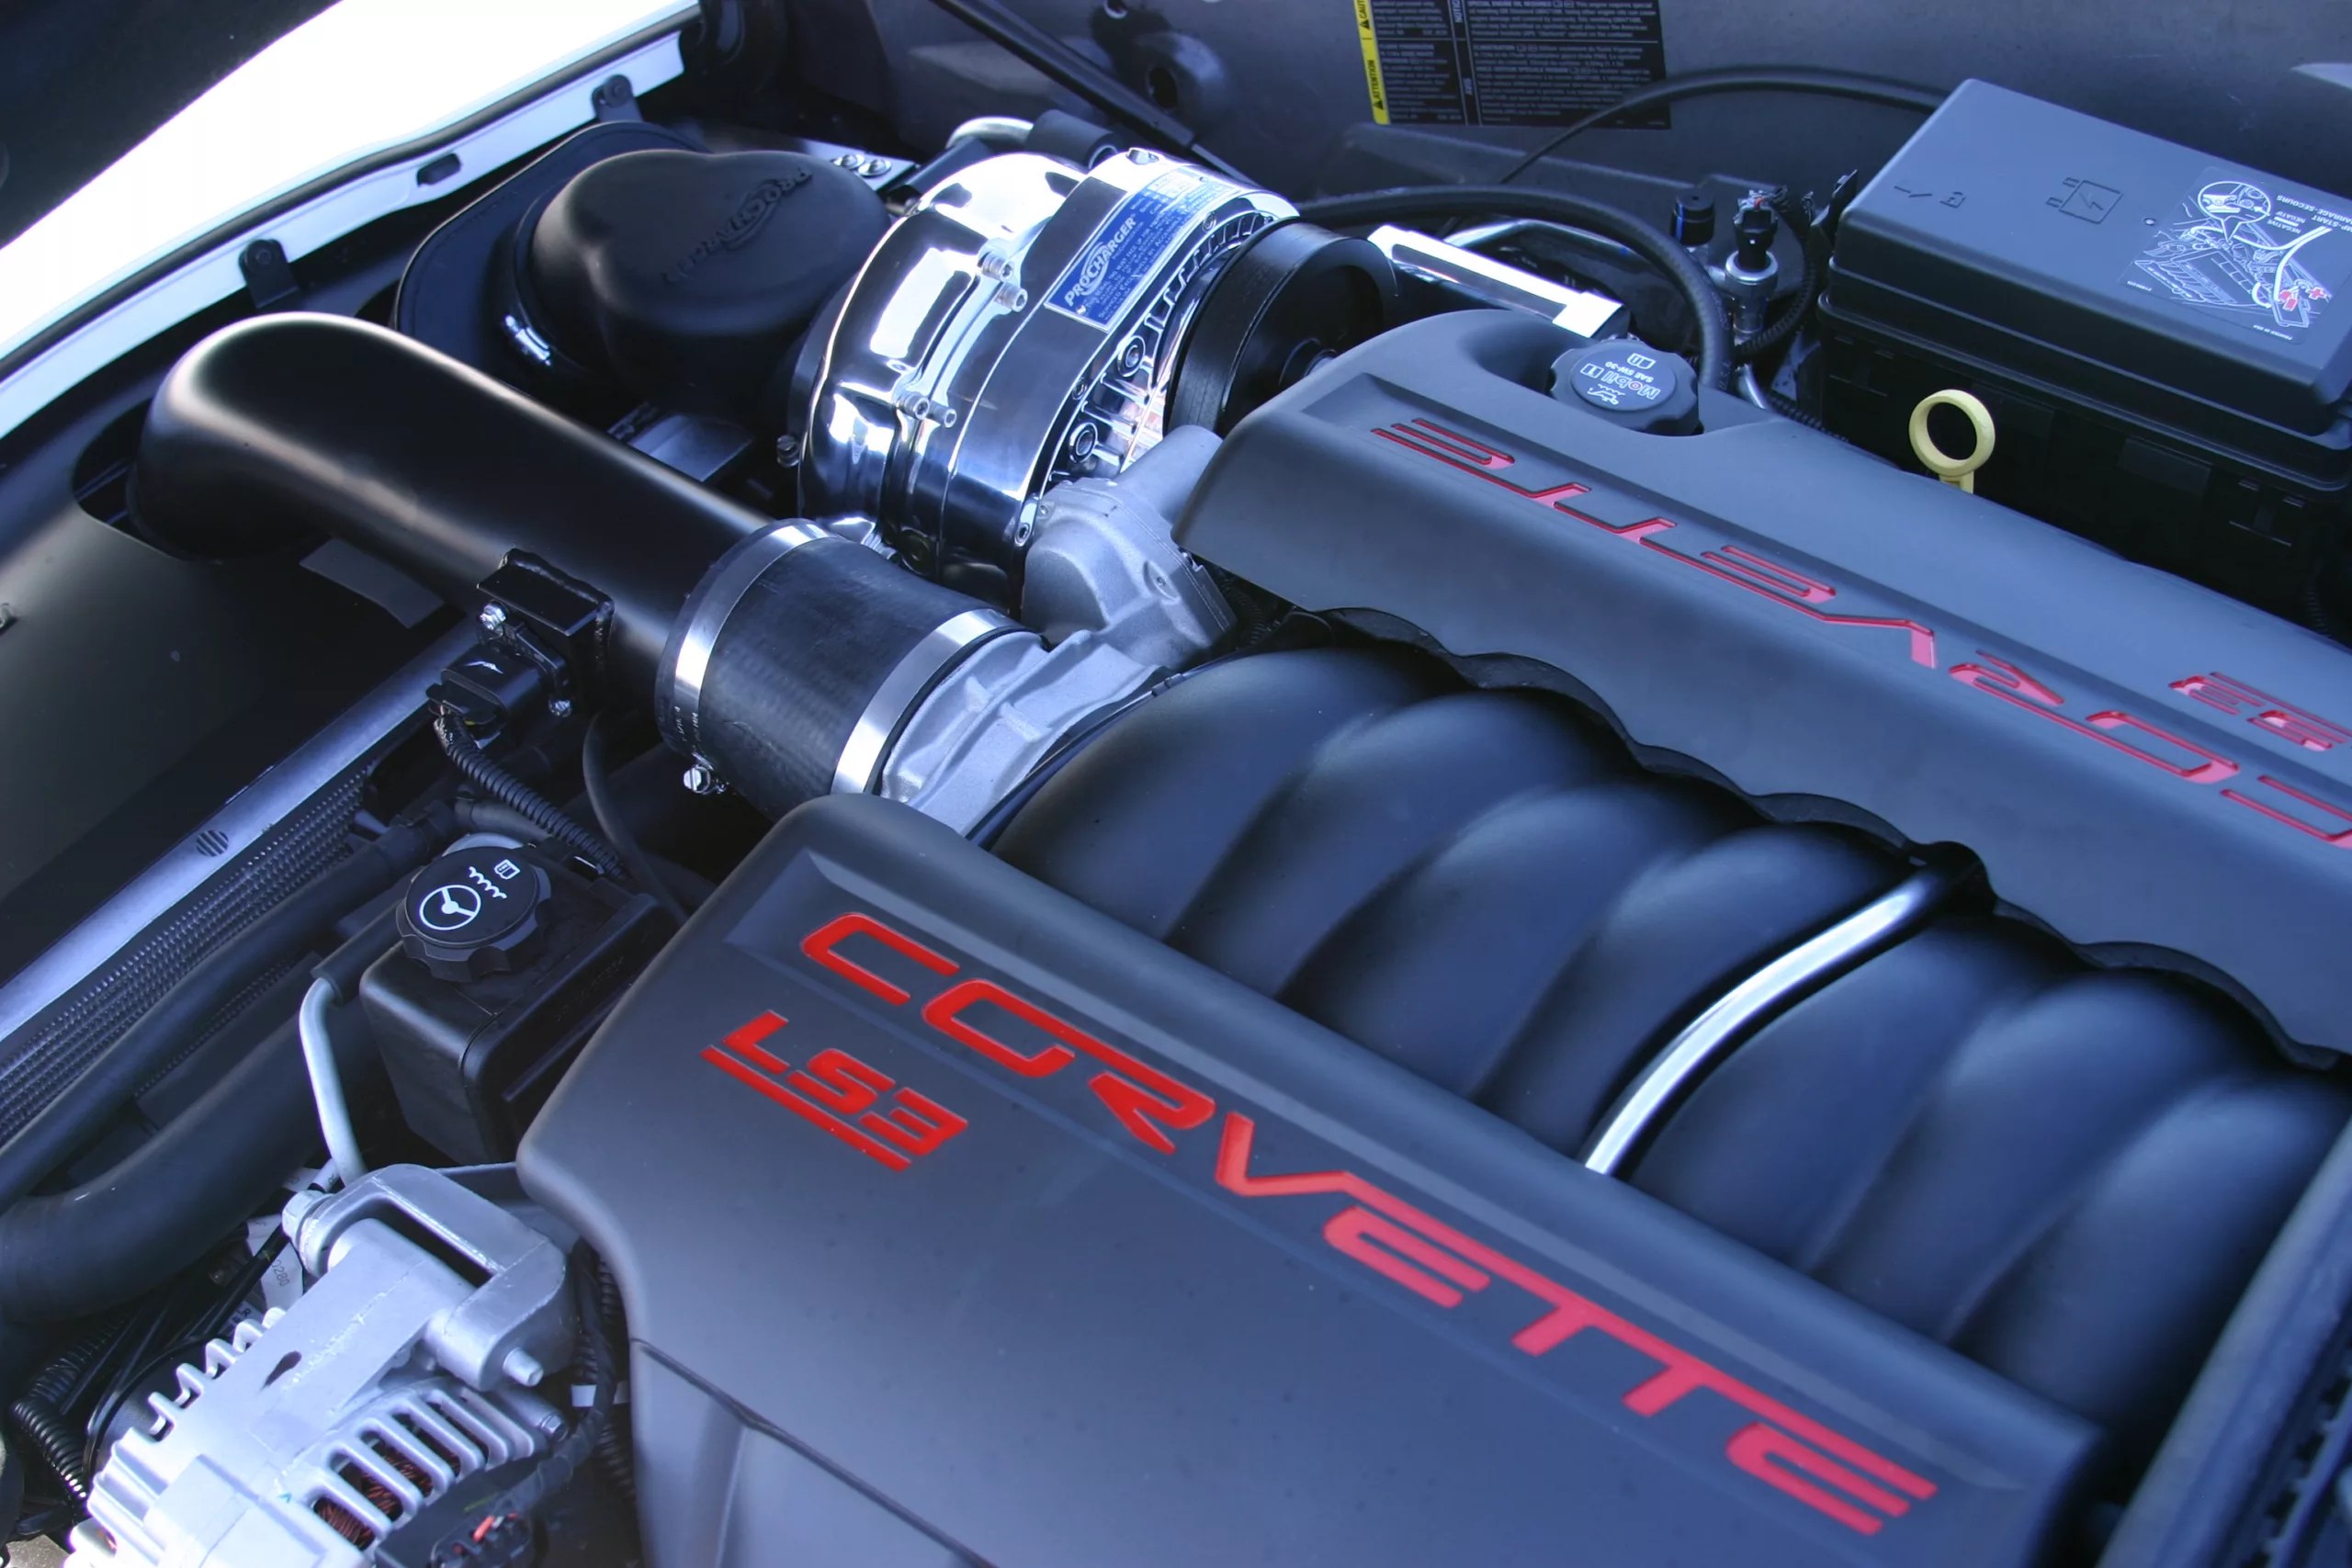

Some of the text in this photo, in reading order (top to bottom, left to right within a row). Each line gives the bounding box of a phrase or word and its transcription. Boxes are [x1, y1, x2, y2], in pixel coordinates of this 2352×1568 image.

[1065, 217, 1136, 307] PROCHARGER
[1600, 370, 1661, 400] Mobil
[1605, 361, 1654, 383] SAE 5W-30
[1371, 418, 2352, 850] CORVETTE
[704, 1009, 968, 1170] LS3
[799, 911, 1939, 1536] CORVETTE
